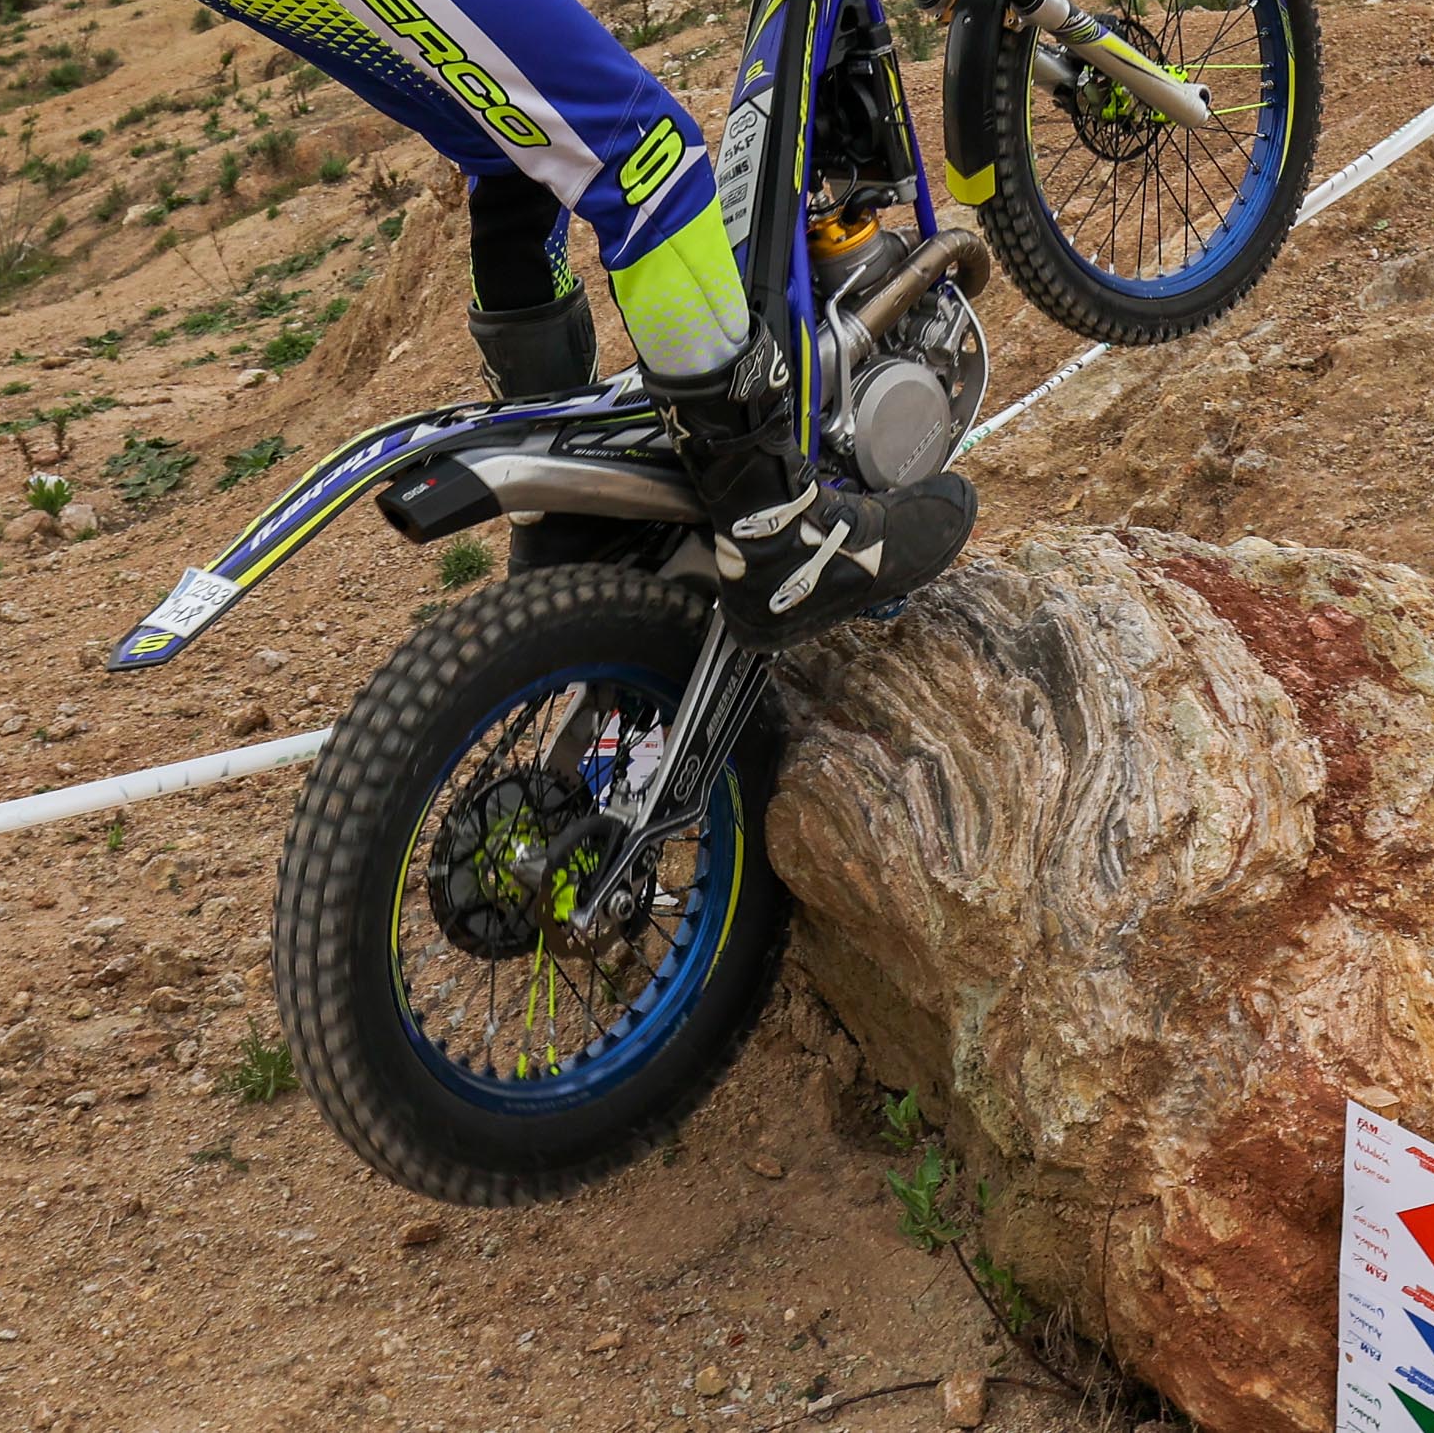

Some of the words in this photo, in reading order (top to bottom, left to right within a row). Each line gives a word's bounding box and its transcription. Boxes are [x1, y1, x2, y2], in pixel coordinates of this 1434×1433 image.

[616, 115, 686, 207] S
[724, 133, 756, 163] SKF
[250, 437, 387, 551] Factory
[186, 580, 232, 606] 2293
[705, 673, 739, 743] MINERVA
[1357, 1117, 1378, 1134] FAM
